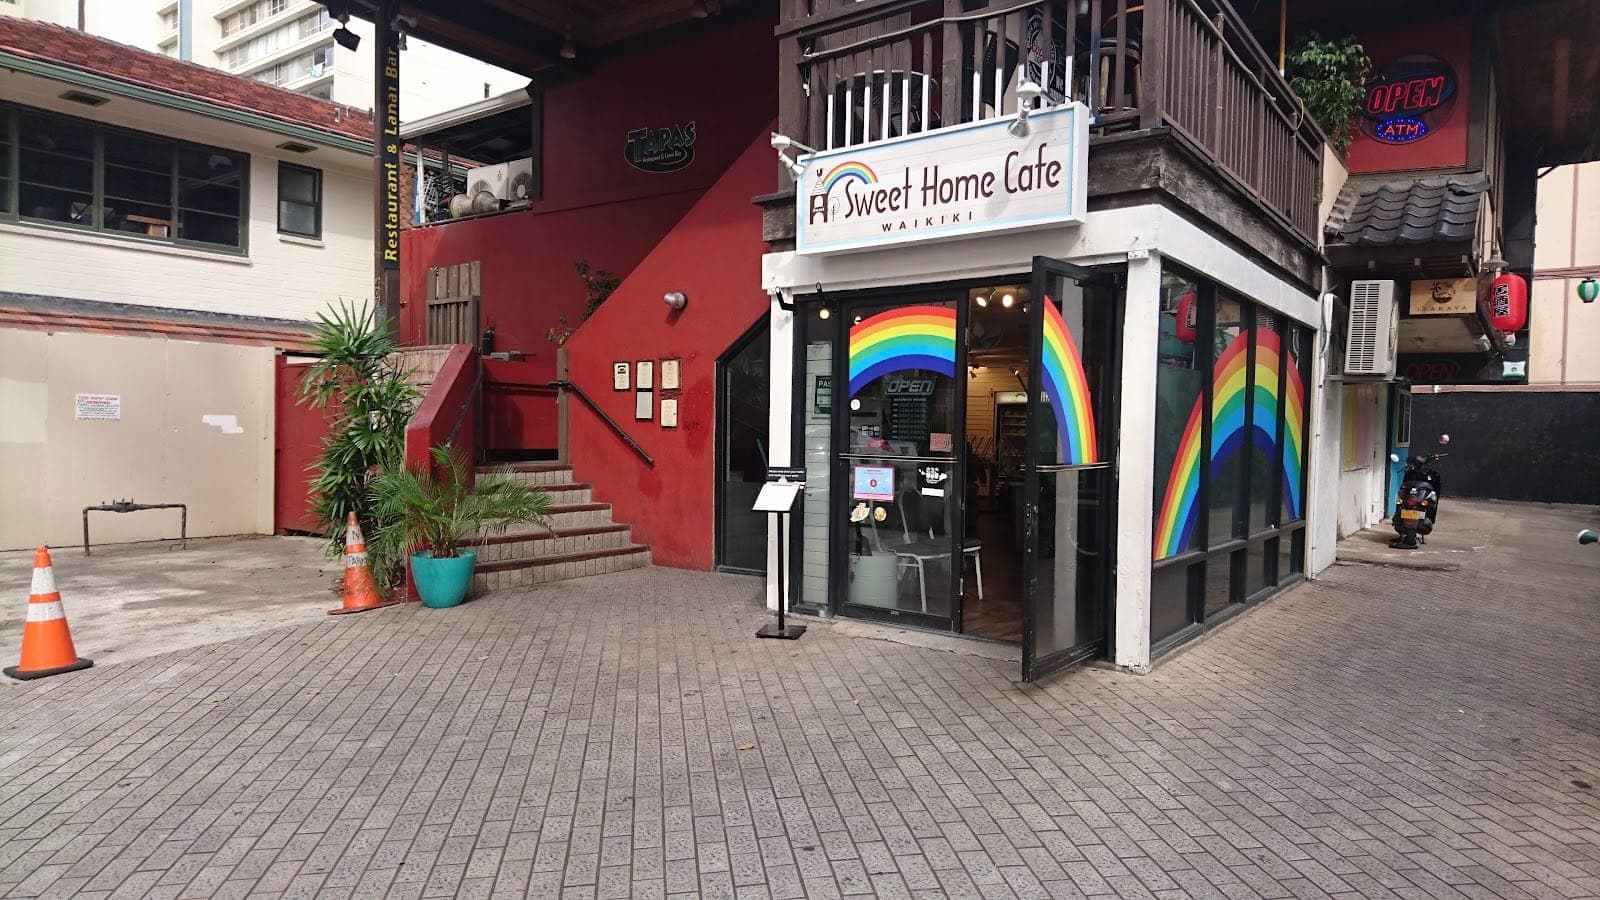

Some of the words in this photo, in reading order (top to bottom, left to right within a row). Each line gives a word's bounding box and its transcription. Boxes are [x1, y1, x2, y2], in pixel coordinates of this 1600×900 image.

[385, 47, 398, 79] Bar
[1367, 76, 1444, 114] OPEN
[384, 86, 398, 135] Lanai
[627, 120, 697, 162] TAPAS
[1384, 124, 1419, 136] ATM
[386, 143, 398, 154] &
[844, 166, 912, 219] Sweet
[920, 164, 994, 207] Home
[1004, 143, 1062, 194] Cafe
[384, 162, 398, 261] Restaurant
[882, 210, 973, 232] WAIKIKI
[1417, 305, 1467, 313] IZAKAYA
[1405, 361, 1455, 379] OPEN
[887, 379, 932, 393] OPEN
